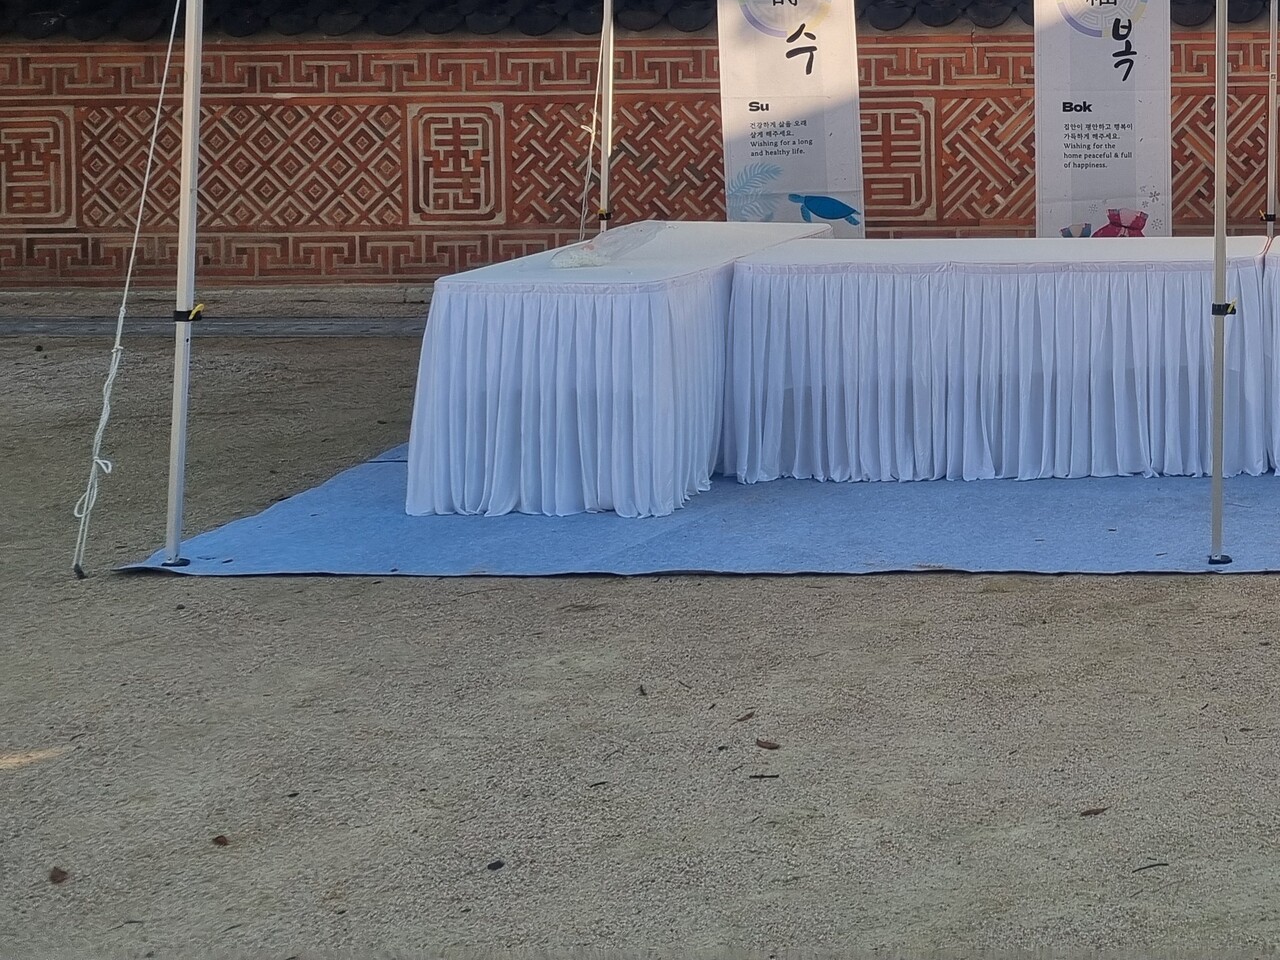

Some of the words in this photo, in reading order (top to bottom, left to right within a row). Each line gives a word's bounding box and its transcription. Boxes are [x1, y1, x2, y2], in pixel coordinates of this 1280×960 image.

[785, 23, 818, 75] 수
[1112, 18, 1137, 82] 복
[748, 101, 769, 112] Su
[1062, 101, 1093, 112] Bok
[750, 140, 778, 148] Wishing
[1064, 143, 1091, 151] Wishing
[765, 149, 791, 157] healthy
[1084, 152, 1112, 160] peaceful
[1073, 162, 1108, 170] happiness.
